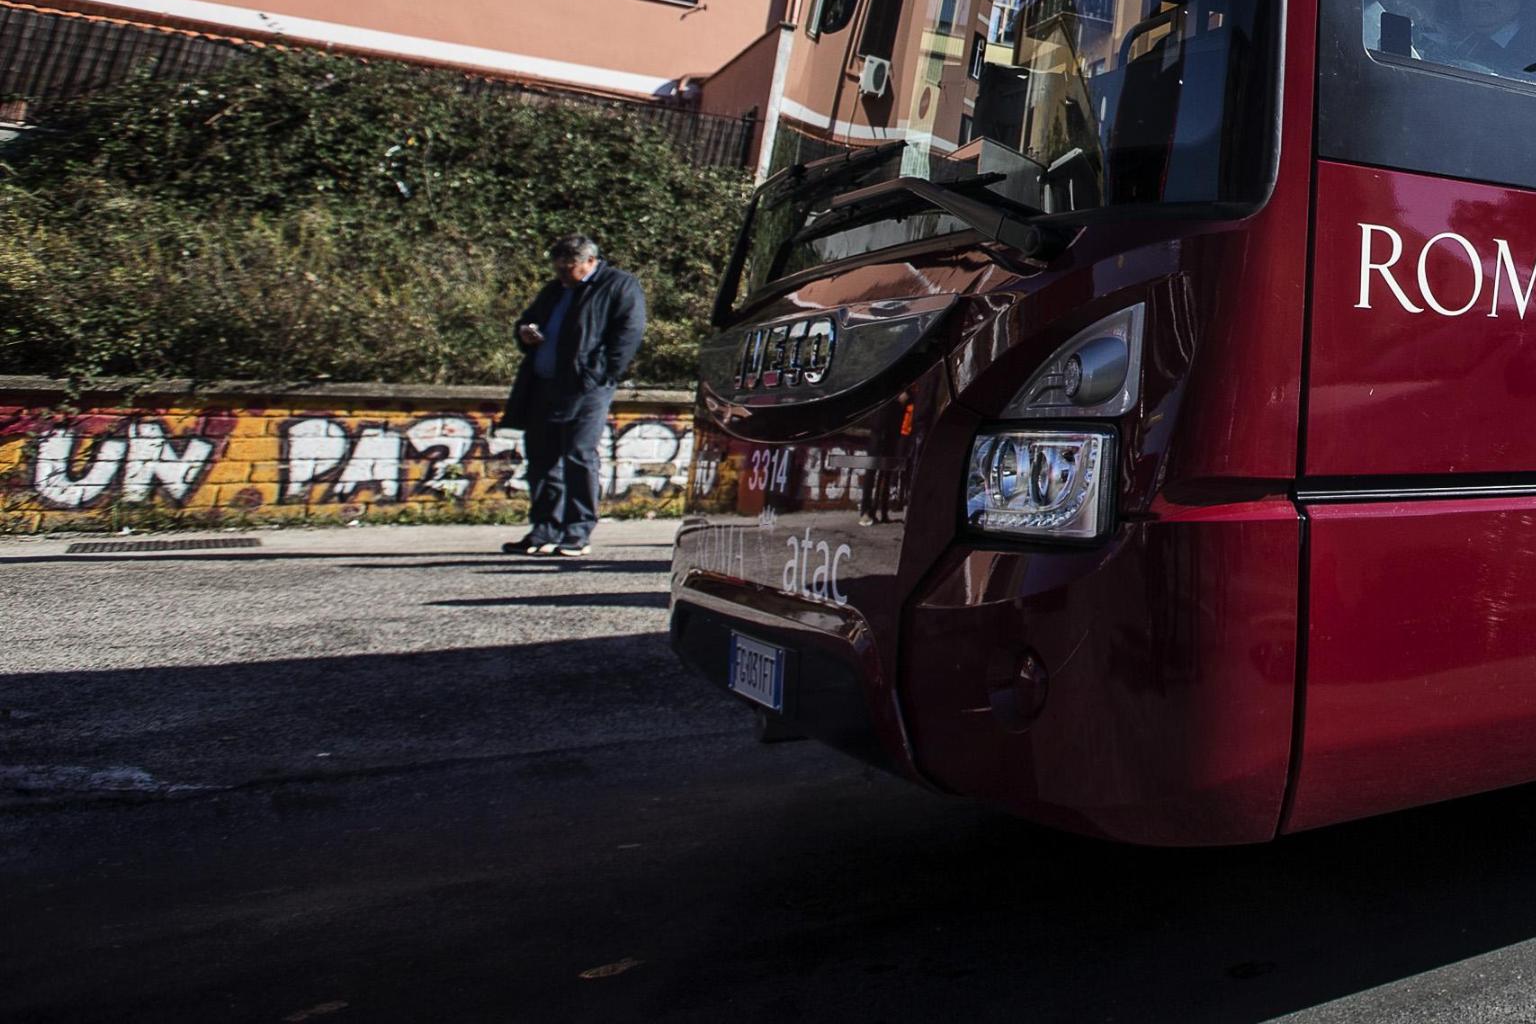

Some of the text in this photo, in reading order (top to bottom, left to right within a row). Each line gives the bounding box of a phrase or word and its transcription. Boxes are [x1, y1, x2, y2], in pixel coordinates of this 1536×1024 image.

[35, 422, 213, 506] UN
[748, 448, 790, 493] 3314
[783, 527, 851, 605] atac
